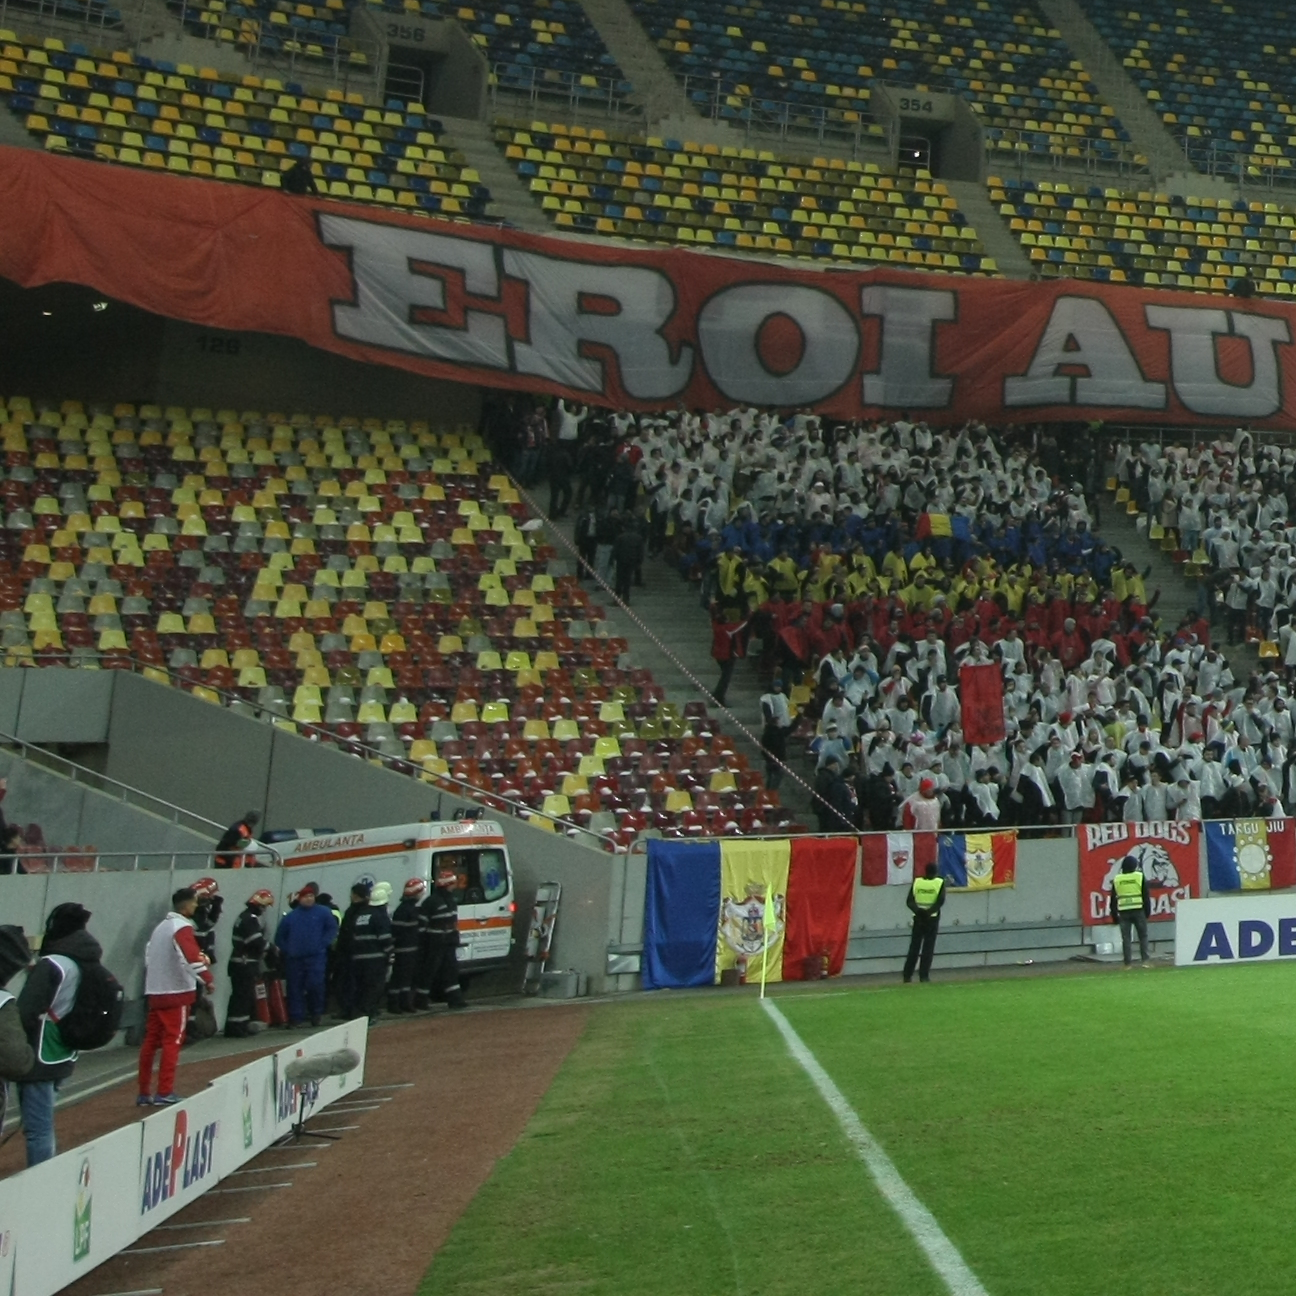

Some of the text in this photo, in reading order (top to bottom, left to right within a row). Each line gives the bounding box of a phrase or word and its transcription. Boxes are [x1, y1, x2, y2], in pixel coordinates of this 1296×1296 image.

[387, 23, 426, 43] 356
[899, 97, 933, 113] 354
[318, 209, 957, 408] EROI
[1005, 296, 1291, 419] AU
[1086, 819, 1191, 852] RED DOGS
[1219, 821, 1285, 835] TARGU JIU
[141, 1109, 218, 1216] ADEPLAST
